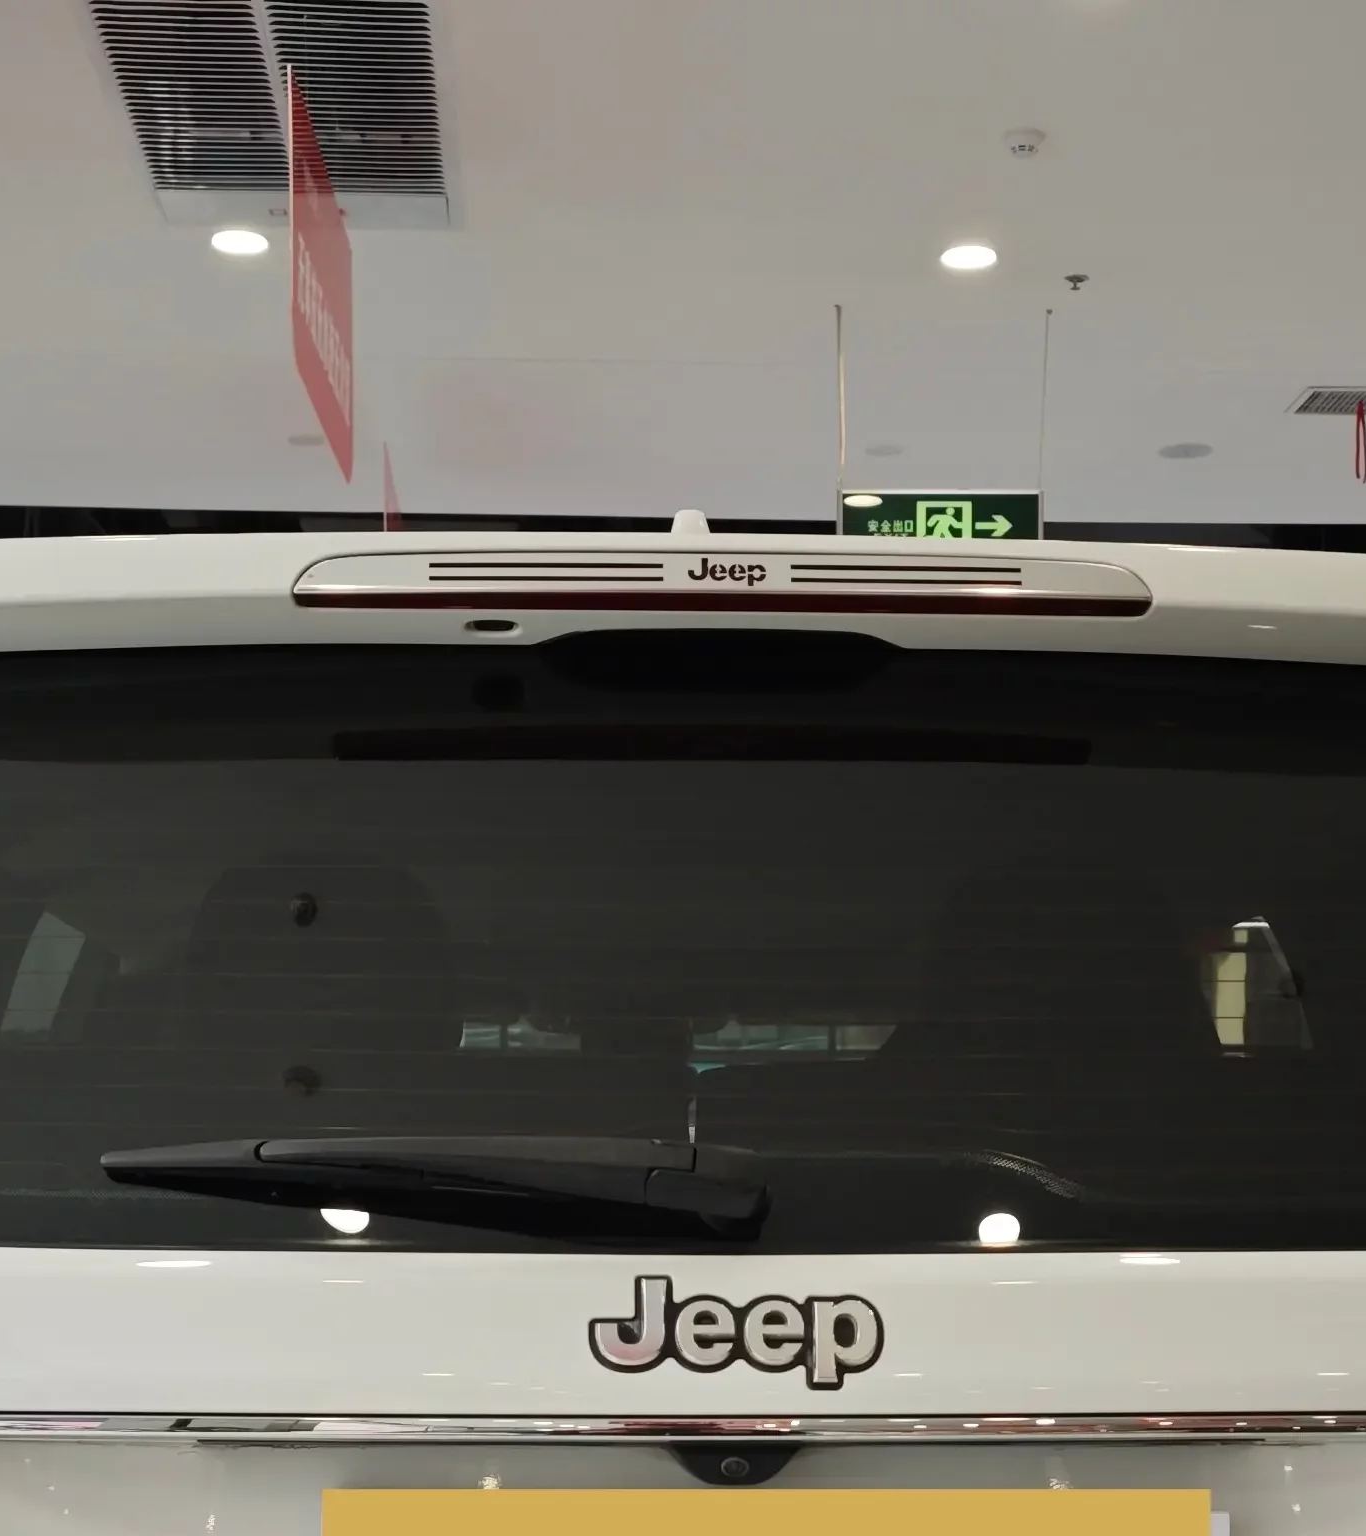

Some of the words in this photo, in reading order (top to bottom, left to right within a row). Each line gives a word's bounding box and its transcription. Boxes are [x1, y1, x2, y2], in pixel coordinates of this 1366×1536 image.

[867, 519, 914, 533] 安全出口
[687, 557, 767, 587] Jeep
[588, 1274, 885, 1391] Jeep
